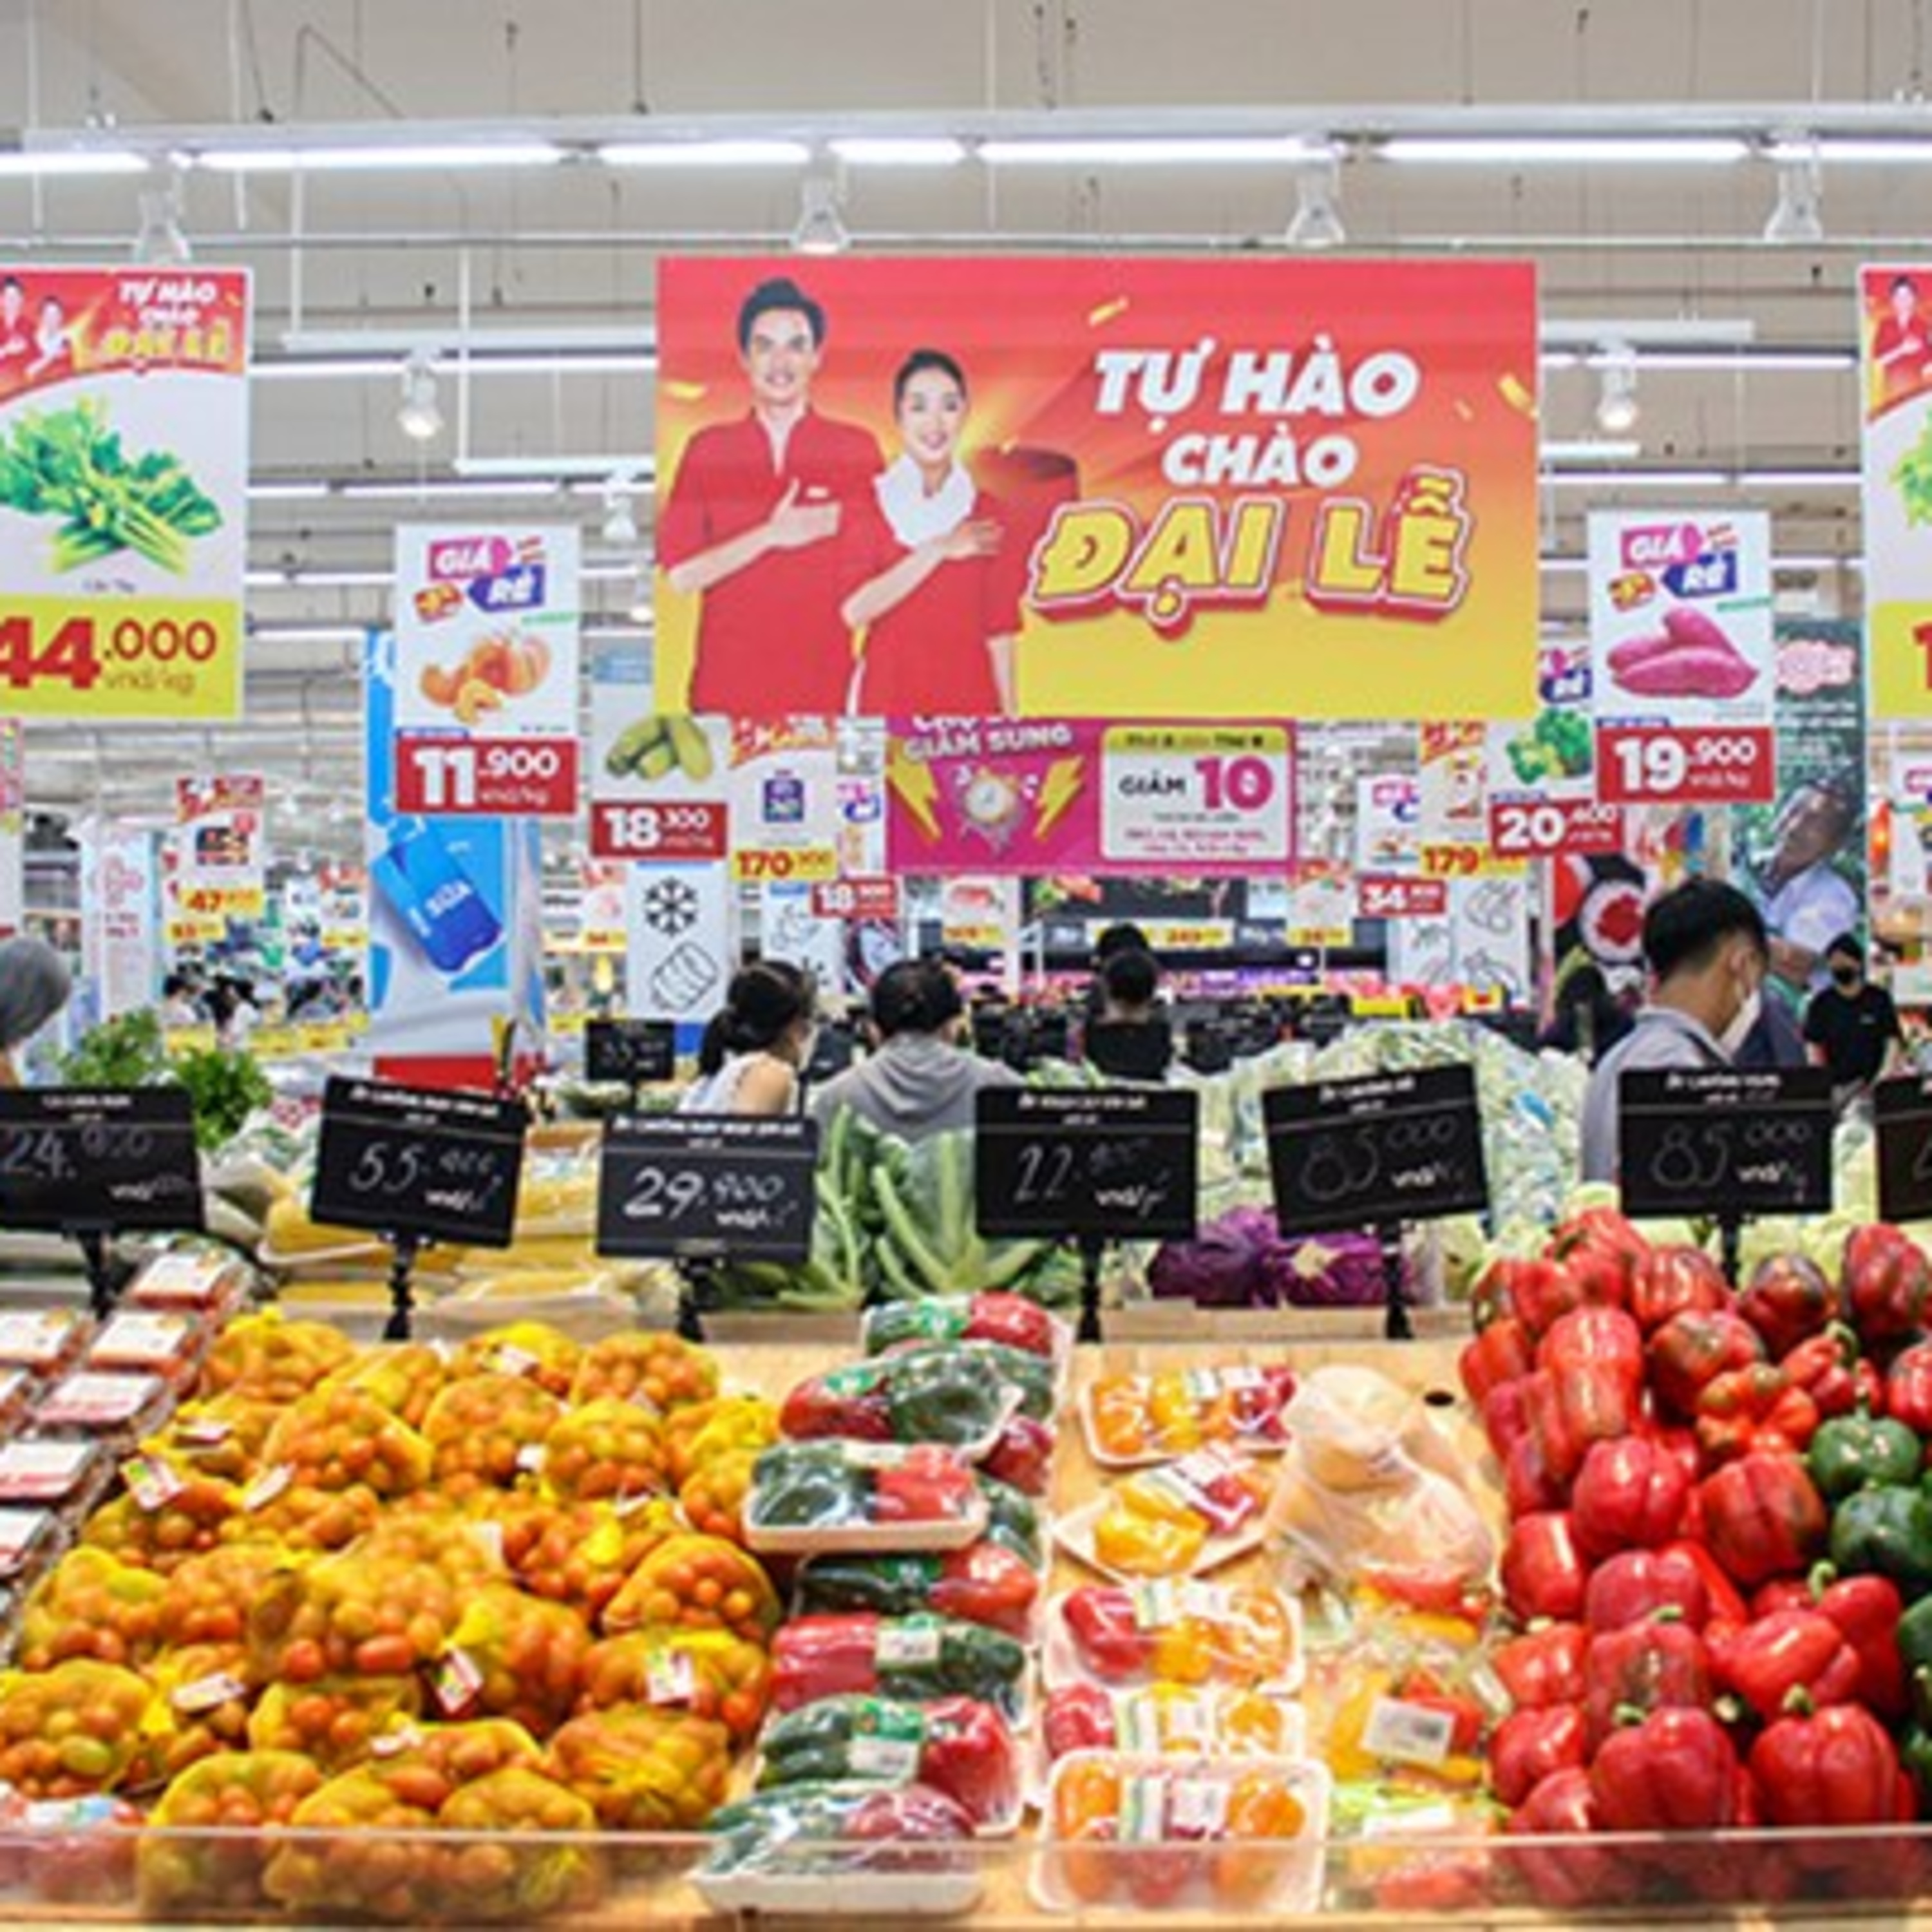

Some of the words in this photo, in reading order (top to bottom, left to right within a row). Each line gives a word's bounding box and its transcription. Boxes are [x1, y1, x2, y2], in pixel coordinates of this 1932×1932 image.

[1095, 337, 1215, 432] TỰ
[1220, 333, 1420, 417] HÀO
[1162, 421, 1359, 487] CHÀO
[1032, 497, 1283, 628] ĐẠI
[1307, 465, 1471, 622] LỄ
[1194, 755, 1274, 811] 10
